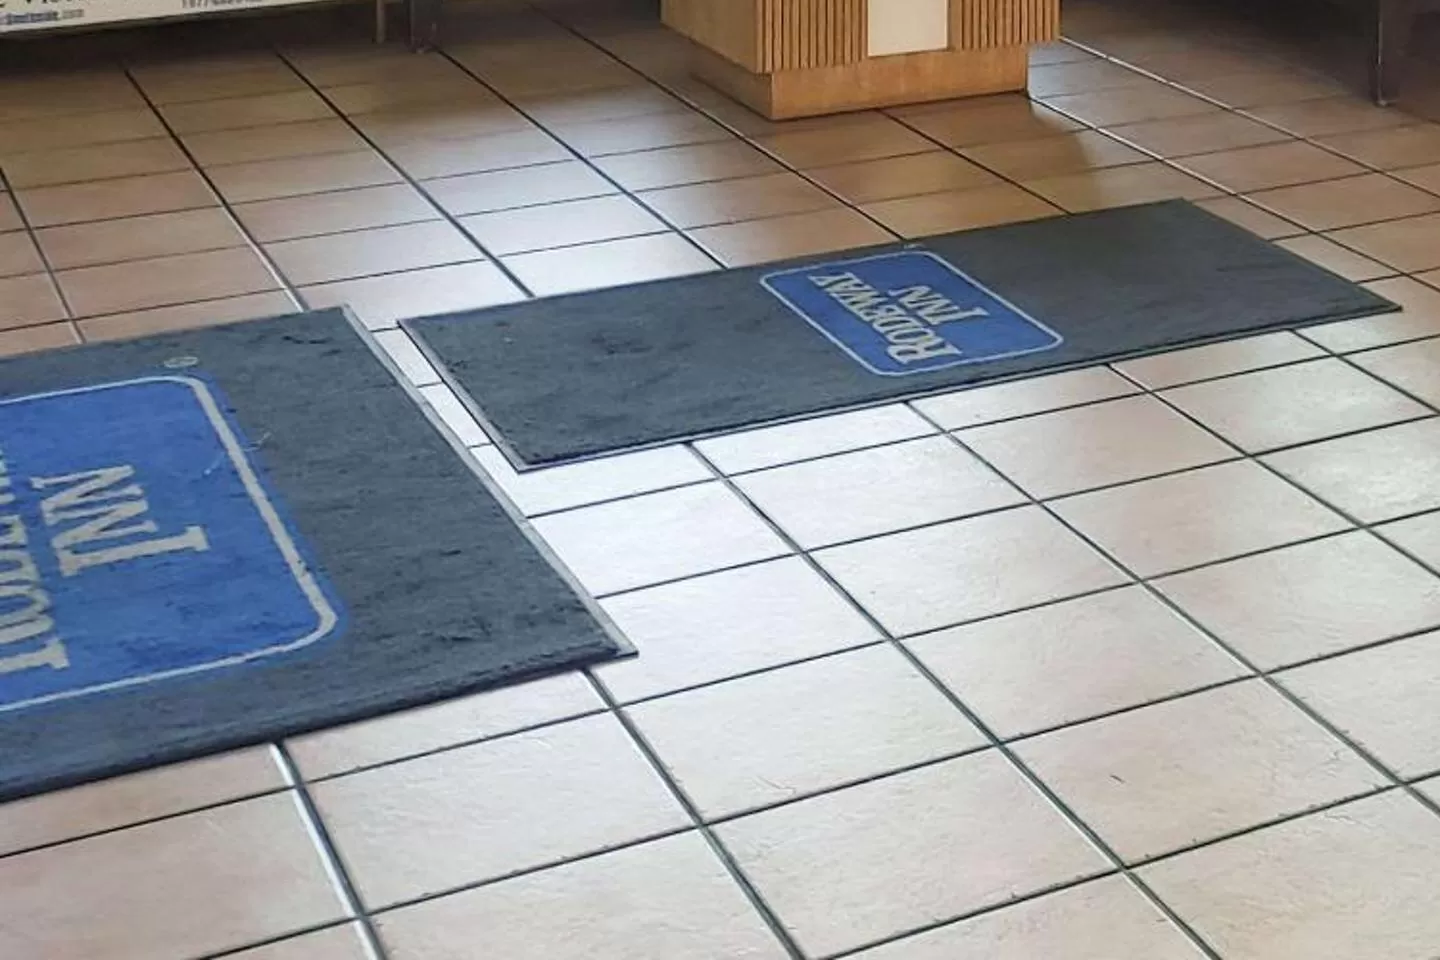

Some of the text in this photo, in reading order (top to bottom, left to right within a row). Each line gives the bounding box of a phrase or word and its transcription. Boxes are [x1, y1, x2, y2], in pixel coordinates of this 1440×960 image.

[807, 272, 962, 364] RODEWAY
[889, 285, 990, 325] INN
[30, 464, 210, 576] INN
